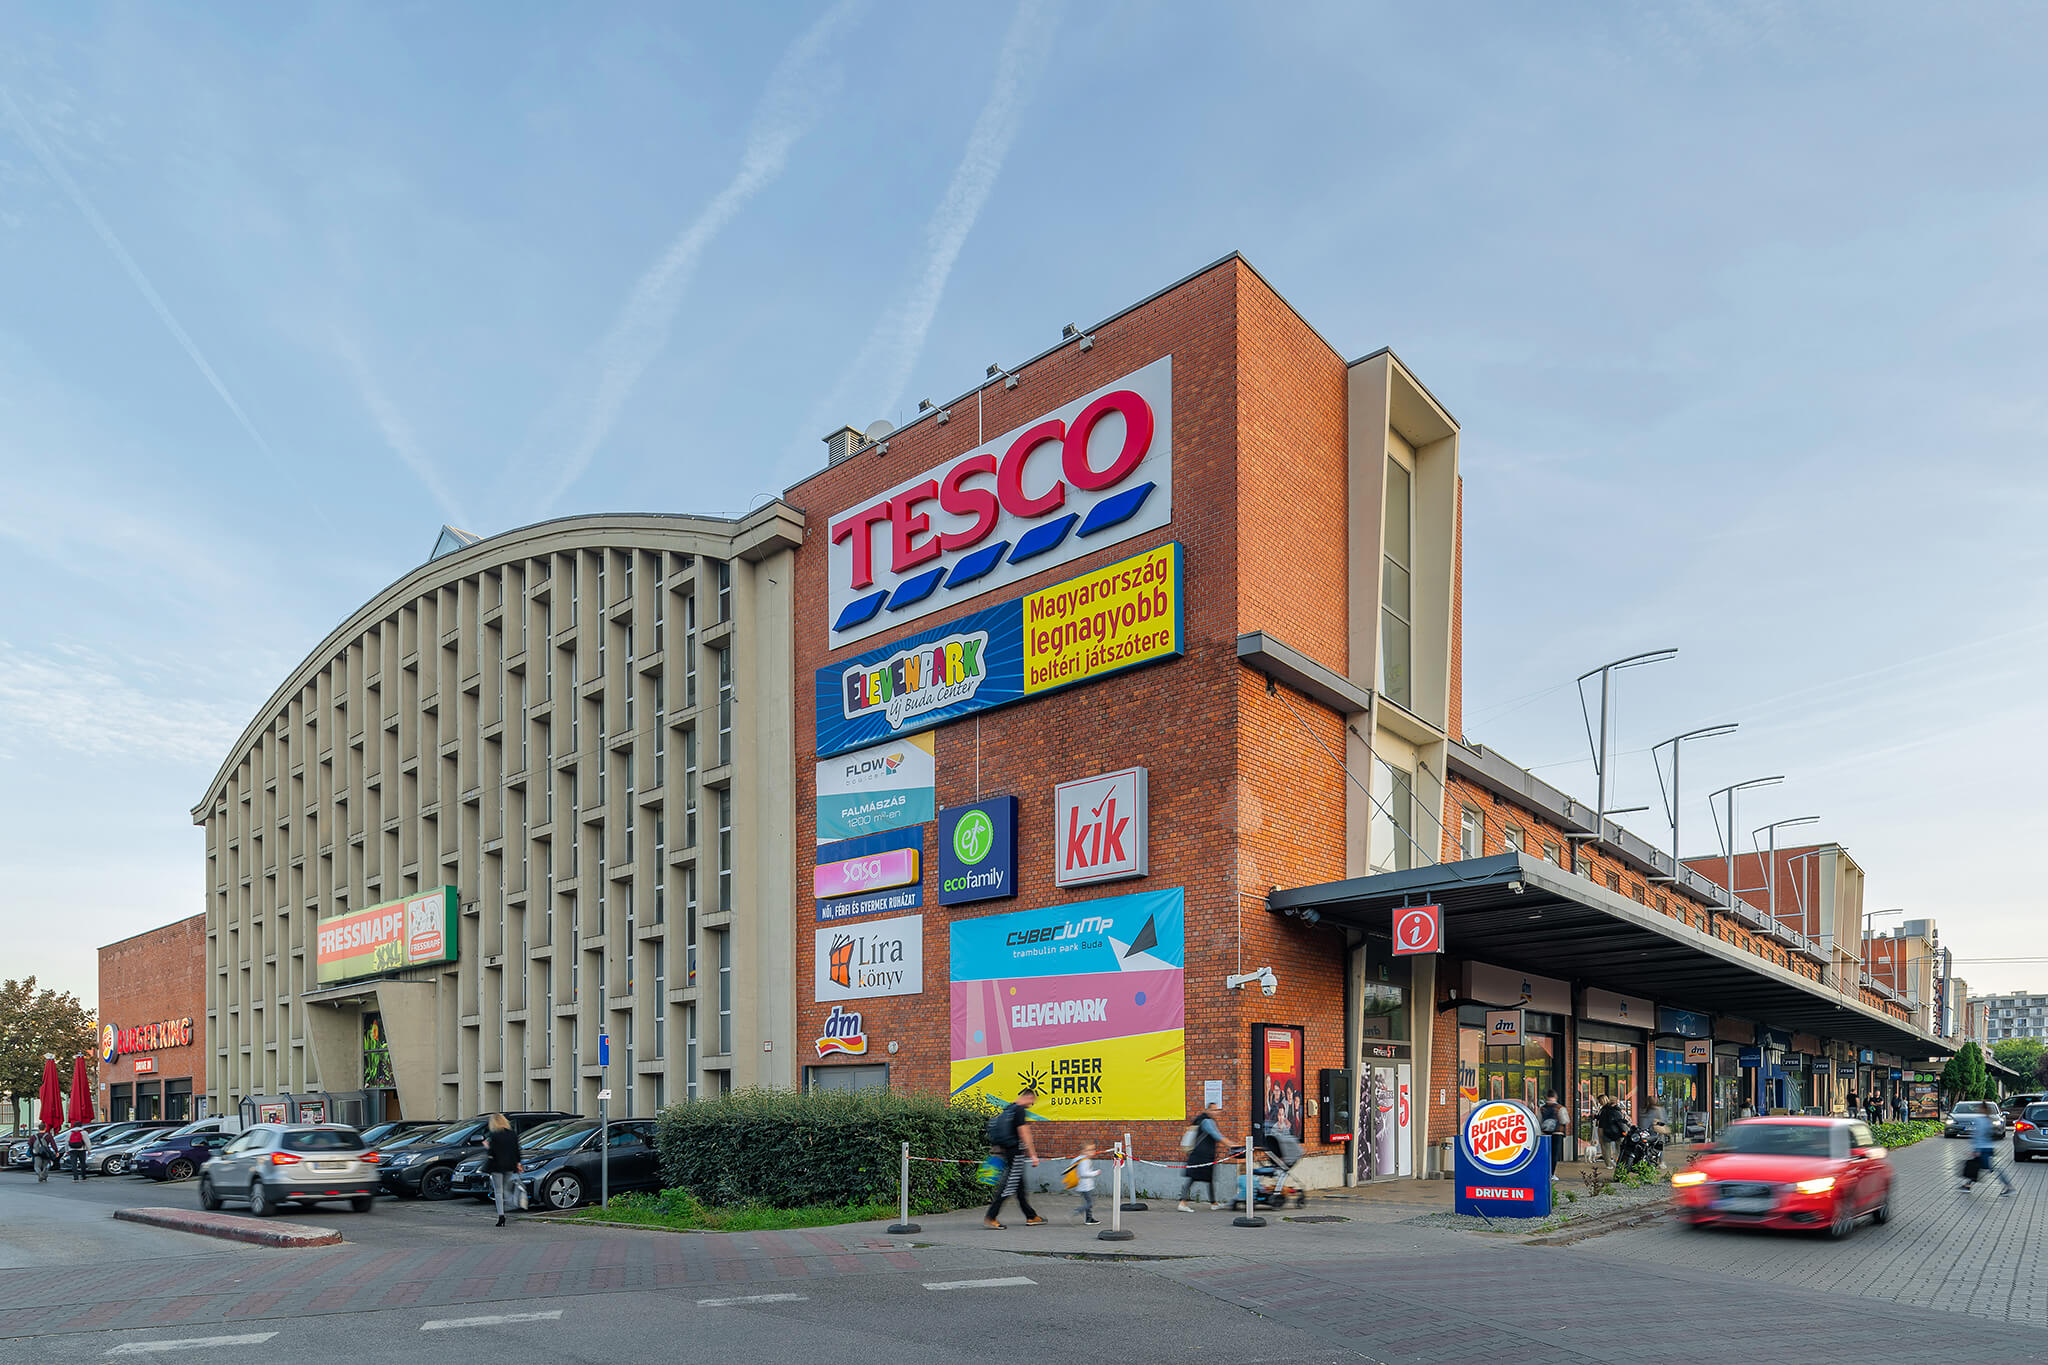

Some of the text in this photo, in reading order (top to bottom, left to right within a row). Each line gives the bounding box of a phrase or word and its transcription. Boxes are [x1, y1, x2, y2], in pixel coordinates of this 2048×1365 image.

[832, 389, 1155, 590] TESCO
[1030, 554, 1167, 623] Magyarország
[1030, 585, 1168, 657] legnagyobb
[1030, 629, 1170, 686] beltéri játszótere
[847, 639, 981, 713] ELEVENPARK
[905, 690, 934, 711] Buda
[937, 681, 974, 702] Center
[846, 757, 884, 777] FLOW
[841, 795, 906, 818] FALMÁSZÁS
[848, 815, 871, 828] 1200
[944, 867, 1004, 893] ecofamily
[821, 892, 916, 920] NŐI, FÉRFI ÉS GYERMEK RUHÁZAT
[318, 911, 402, 956] FRESSNAPF
[411, 938, 441, 953] FRESSNAPF
[375, 939, 401, 970] XXL
[858, 934, 904, 966] Líra
[1013, 940, 1103, 958] trambulin park Buda
[858, 969, 904, 990] könyv
[826, 1008, 860, 1038] dm
[1011, 998, 1108, 1028] ELEVENPARK
[1495, 1019, 1514, 1030] dm
[117, 1023, 157, 1055] BURGER
[159, 1017, 191, 1049] KING
[1691, 1046, 1705, 1054] dm
[1050, 1058, 1102, 1075] LASER
[1050, 1076, 1102, 1094] PARK
[1050, 1096, 1103, 1105] BUDAPEST
[1471, 1114, 1525, 1139] BURGER
[1474, 1126, 1528, 1156] KING
[1475, 1188, 1524, 1199] DRIVE IN
